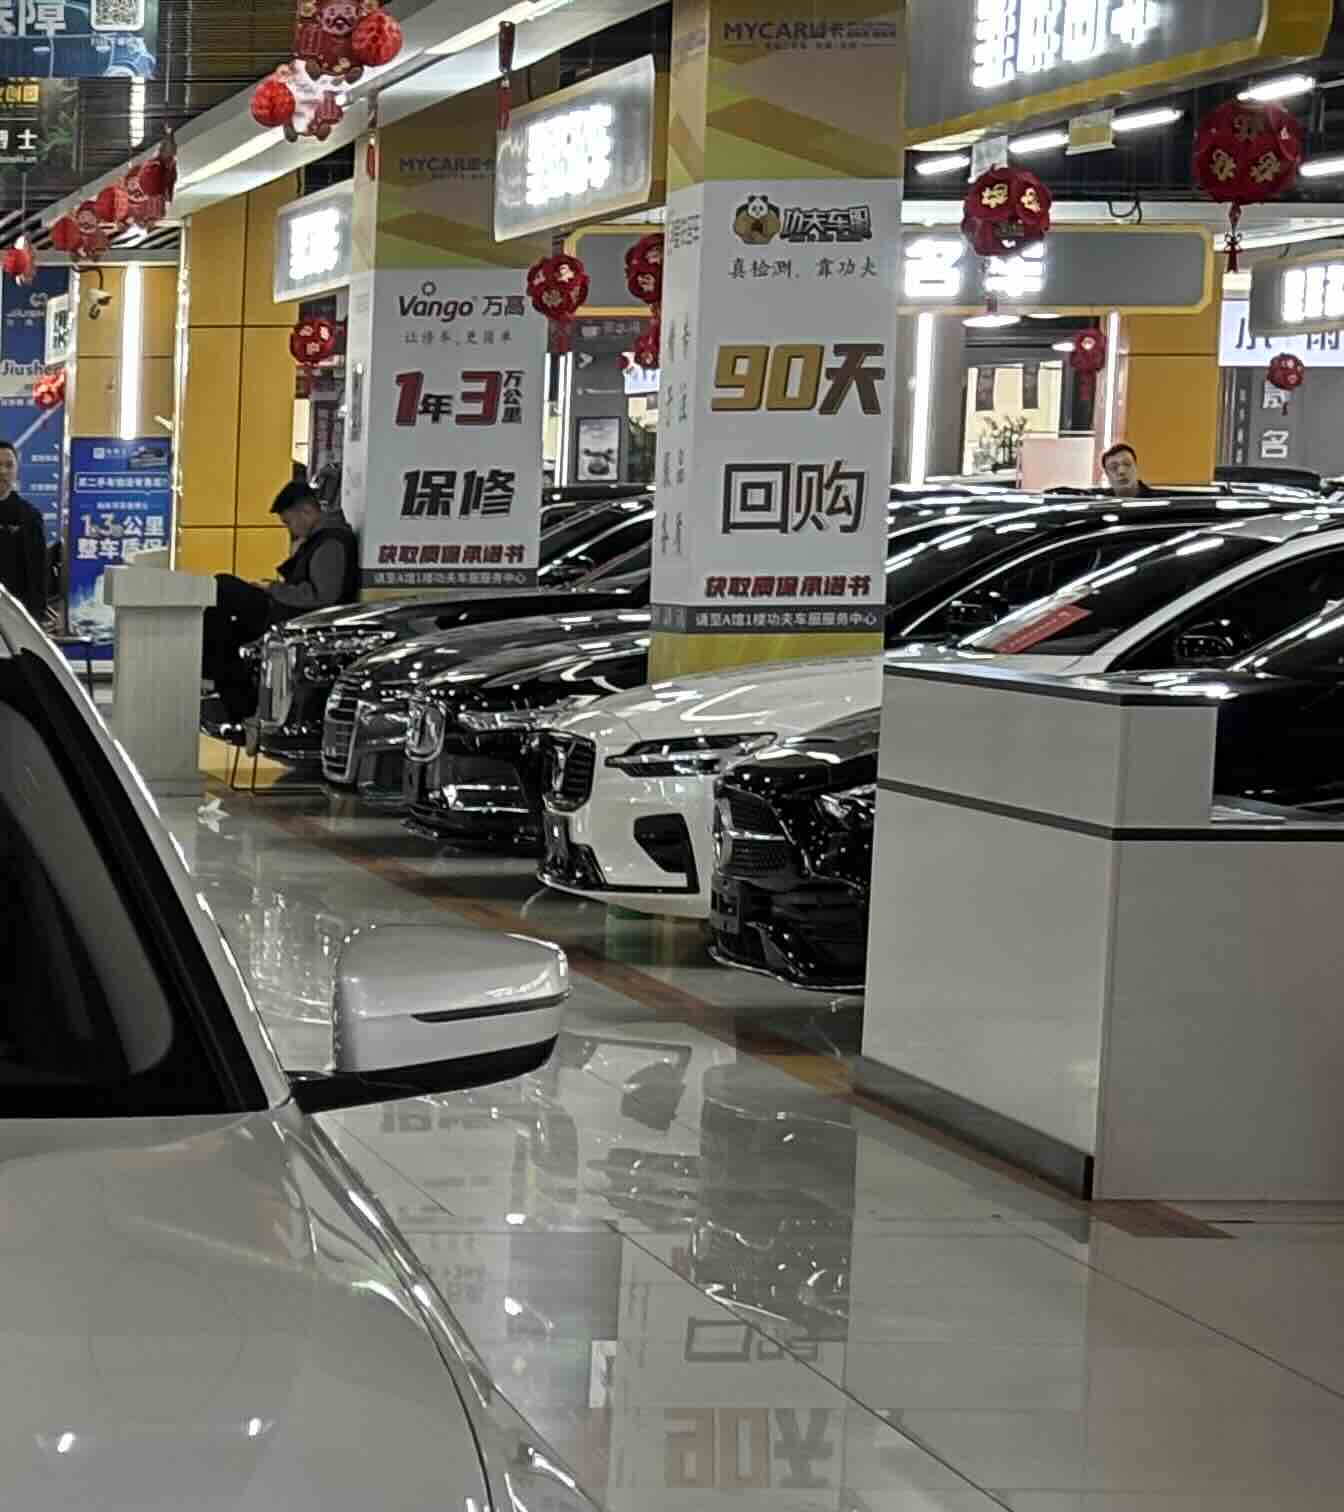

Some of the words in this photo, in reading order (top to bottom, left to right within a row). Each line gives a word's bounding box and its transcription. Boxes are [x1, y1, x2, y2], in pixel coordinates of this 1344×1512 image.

[709, 342, 887, 416] 90天
[400, 468, 516, 518] 保修
[720, 459, 867, 535] 回购
